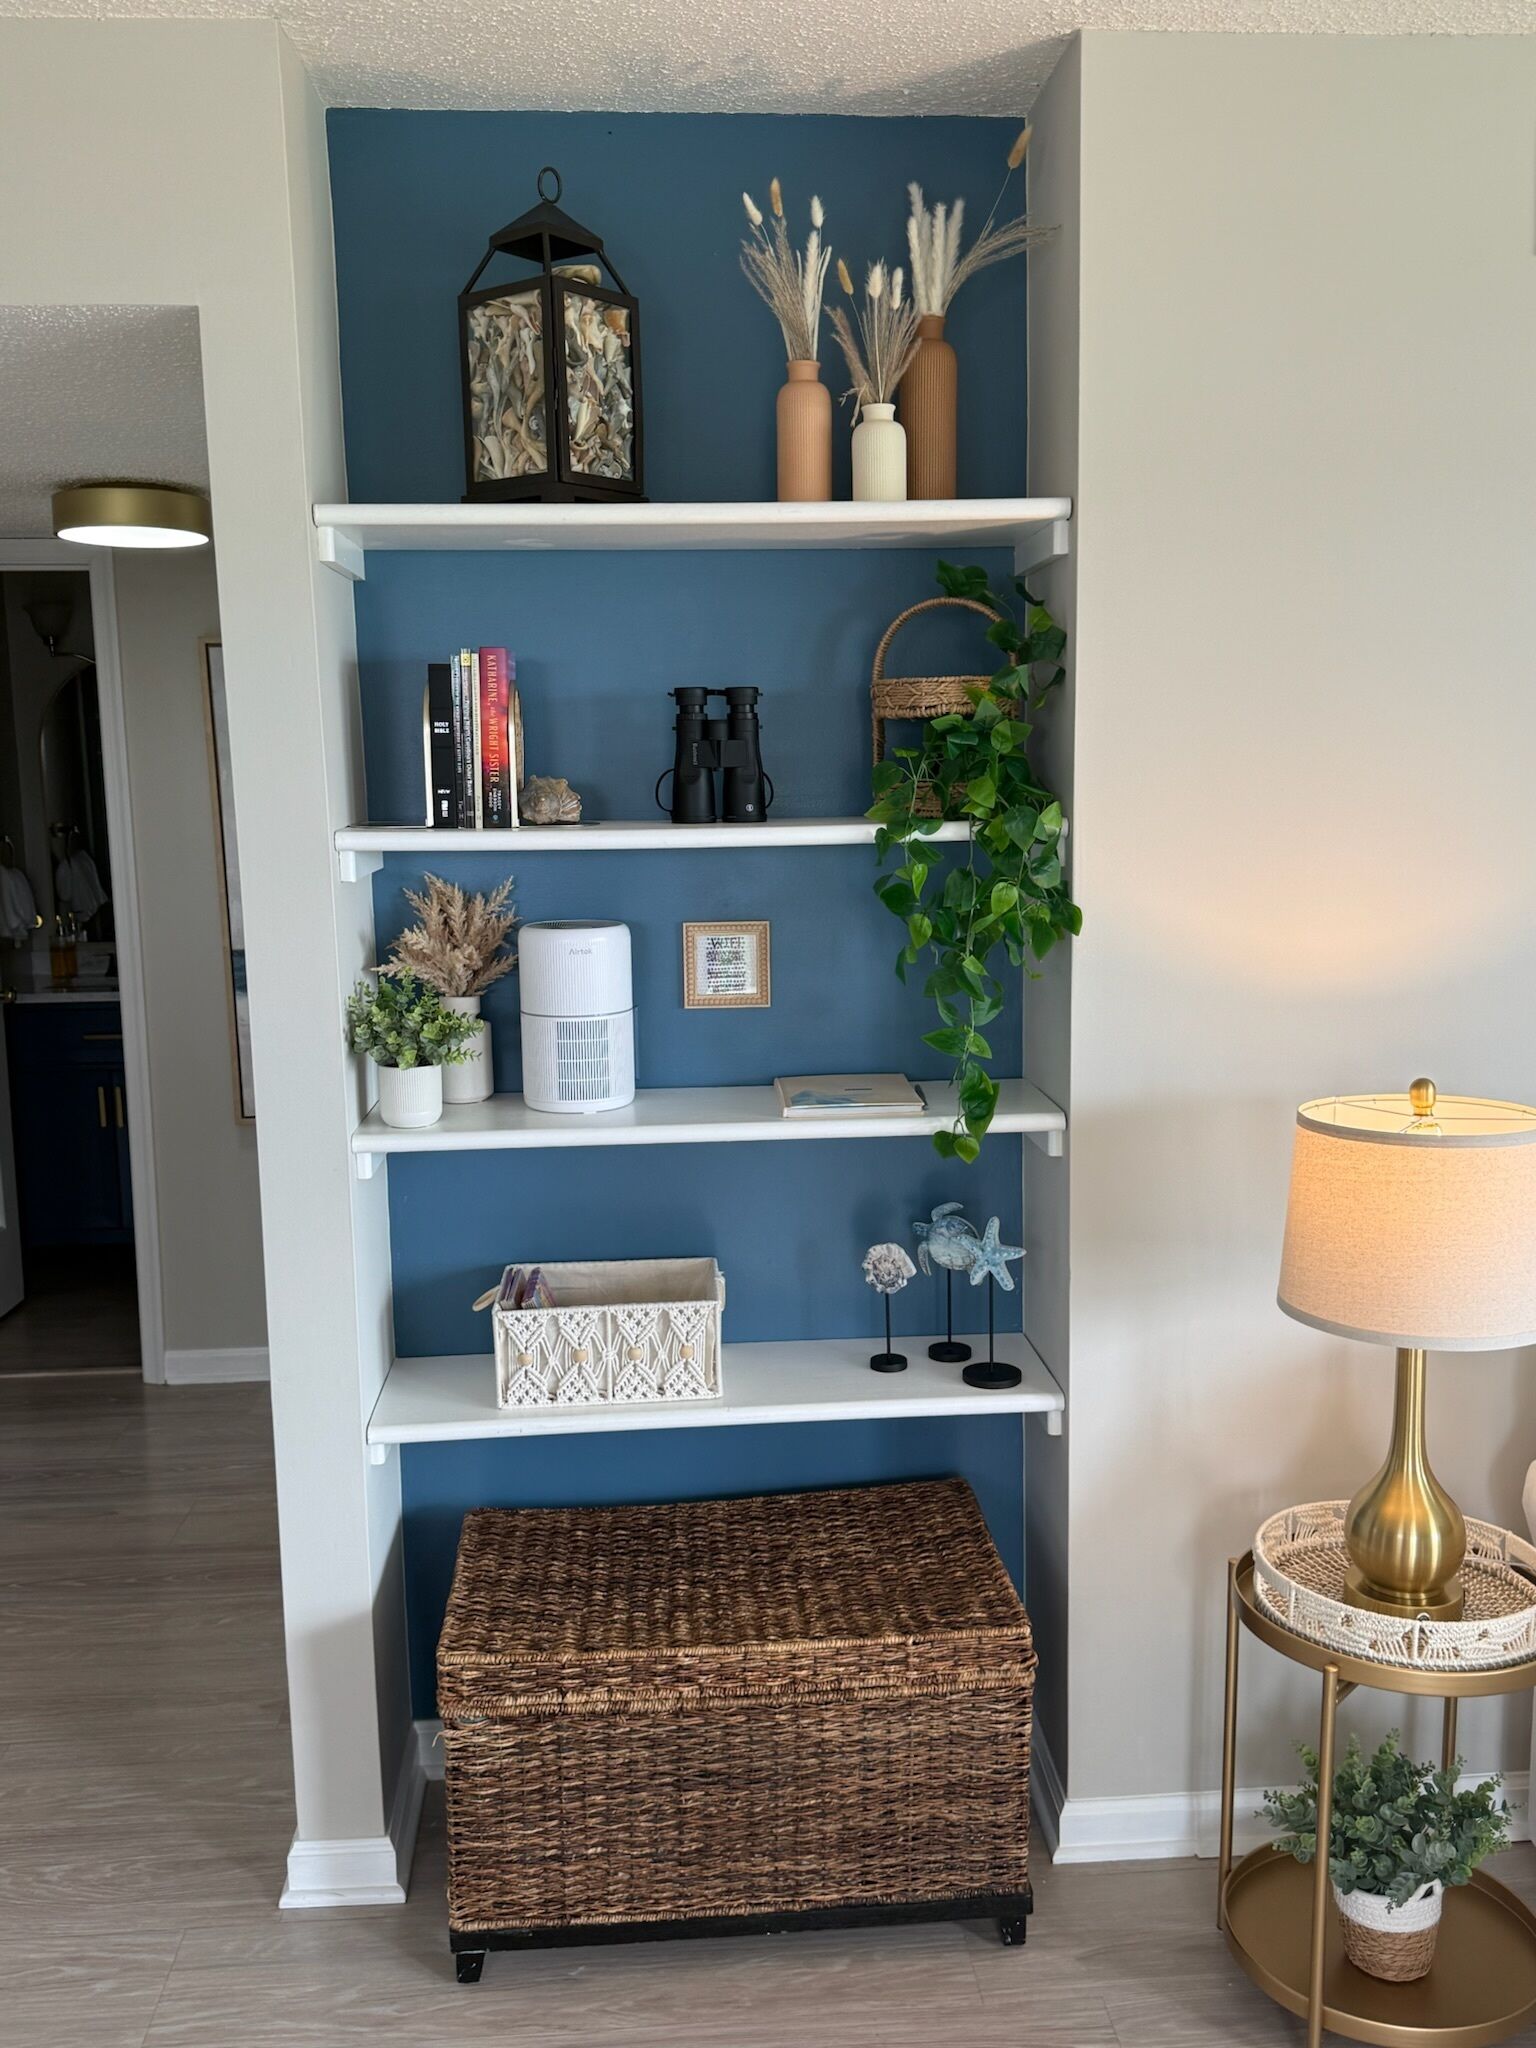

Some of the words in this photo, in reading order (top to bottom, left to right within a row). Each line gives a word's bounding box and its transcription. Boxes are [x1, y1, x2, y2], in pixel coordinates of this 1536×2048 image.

[487, 654, 498, 706] KATHARINE,
[488, 717, 499, 751] WRIGHT
[489, 753, 500, 783] SISTER
